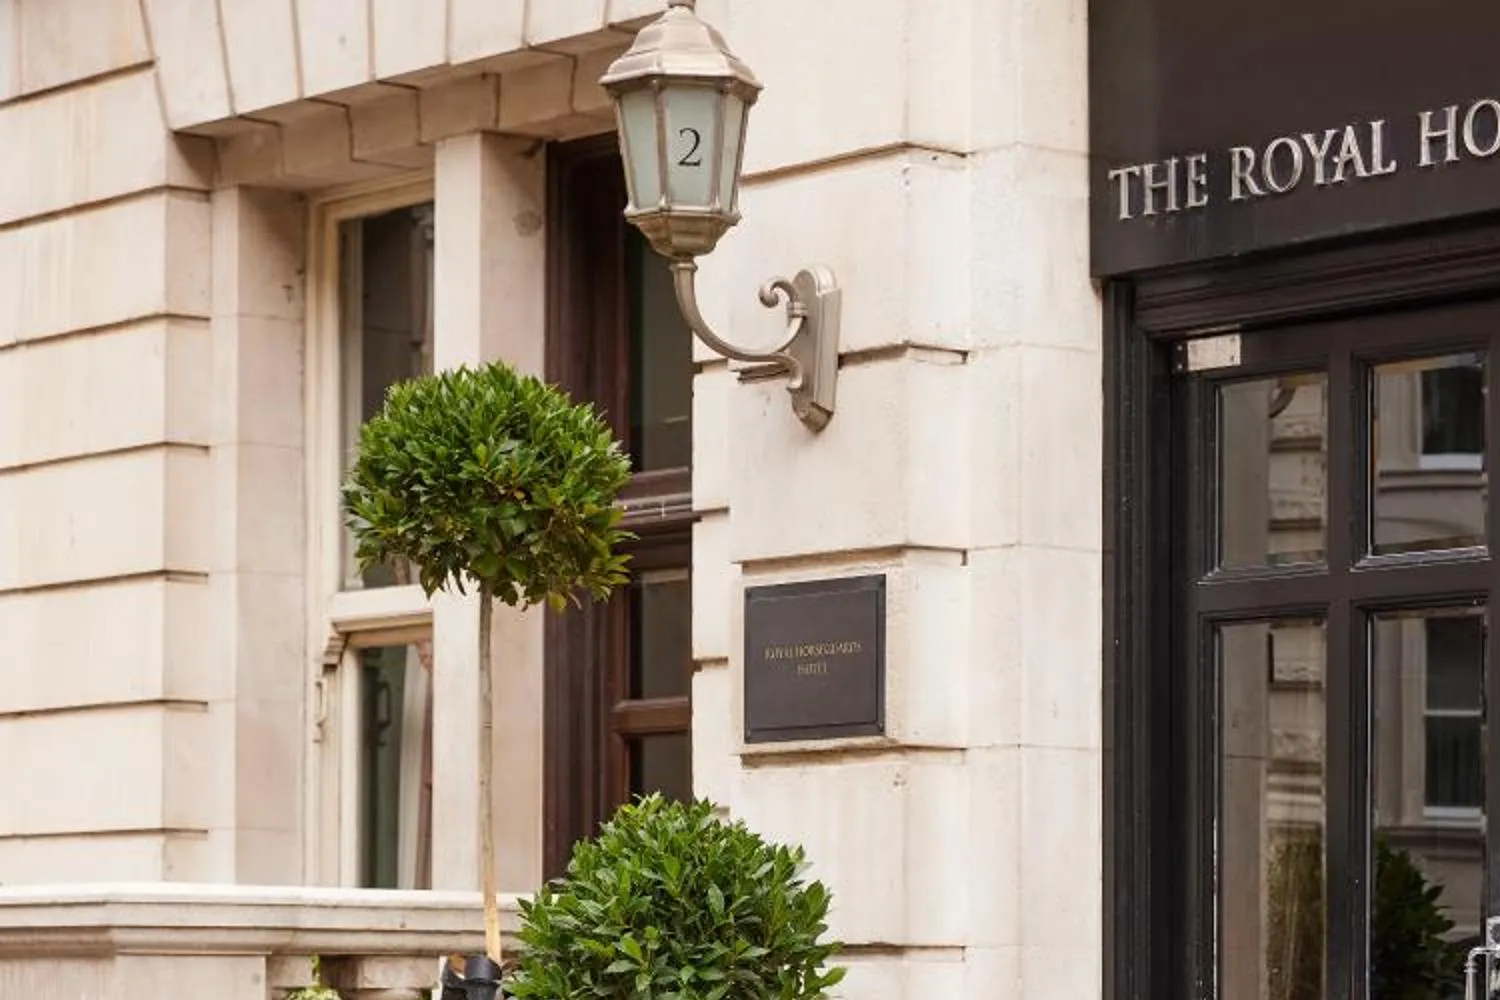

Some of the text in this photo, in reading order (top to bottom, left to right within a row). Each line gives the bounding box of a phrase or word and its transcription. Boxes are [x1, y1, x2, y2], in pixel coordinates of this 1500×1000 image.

[678, 128, 701, 166] 2
[1107, 153, 1209, 221] THE
[1229, 119, 1398, 201] ROYAL
